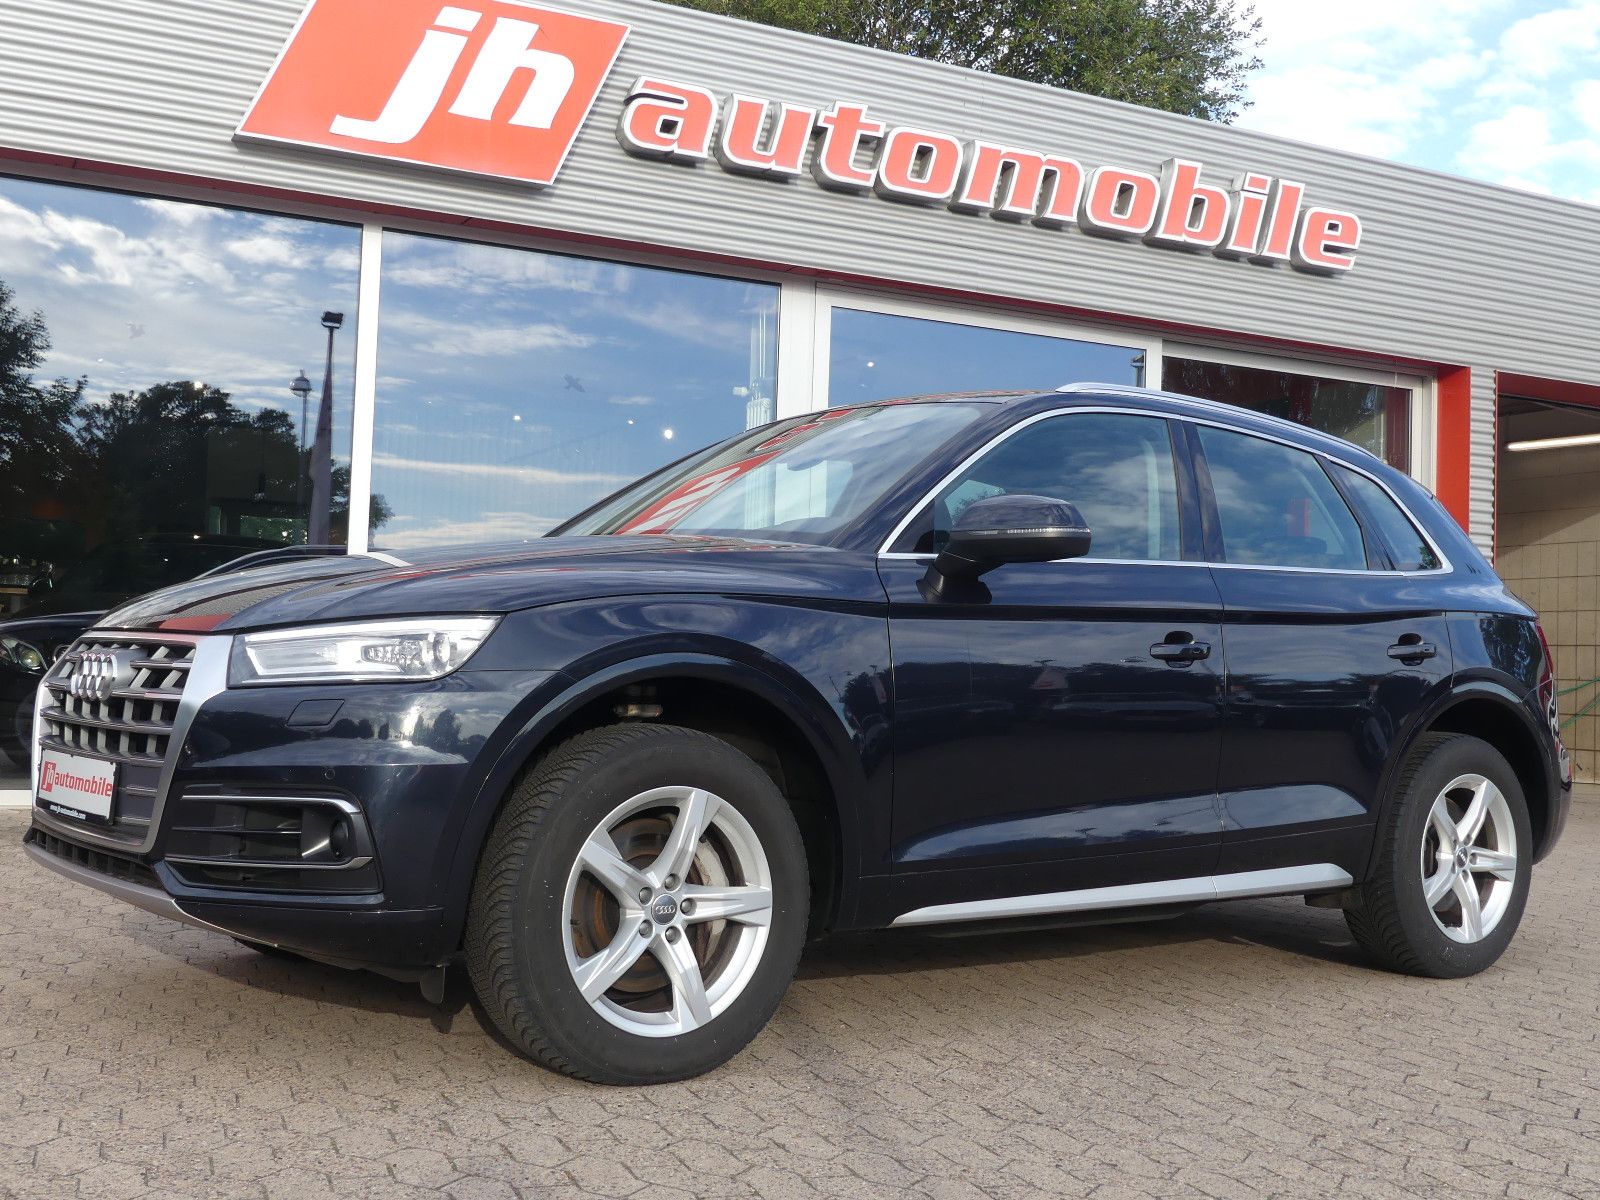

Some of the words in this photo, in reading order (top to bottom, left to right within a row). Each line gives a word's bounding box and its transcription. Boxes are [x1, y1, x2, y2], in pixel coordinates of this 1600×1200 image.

[328, 6, 576, 144] jh
[619, 76, 1363, 272] automobile
[54, 772, 112, 797] automobile
